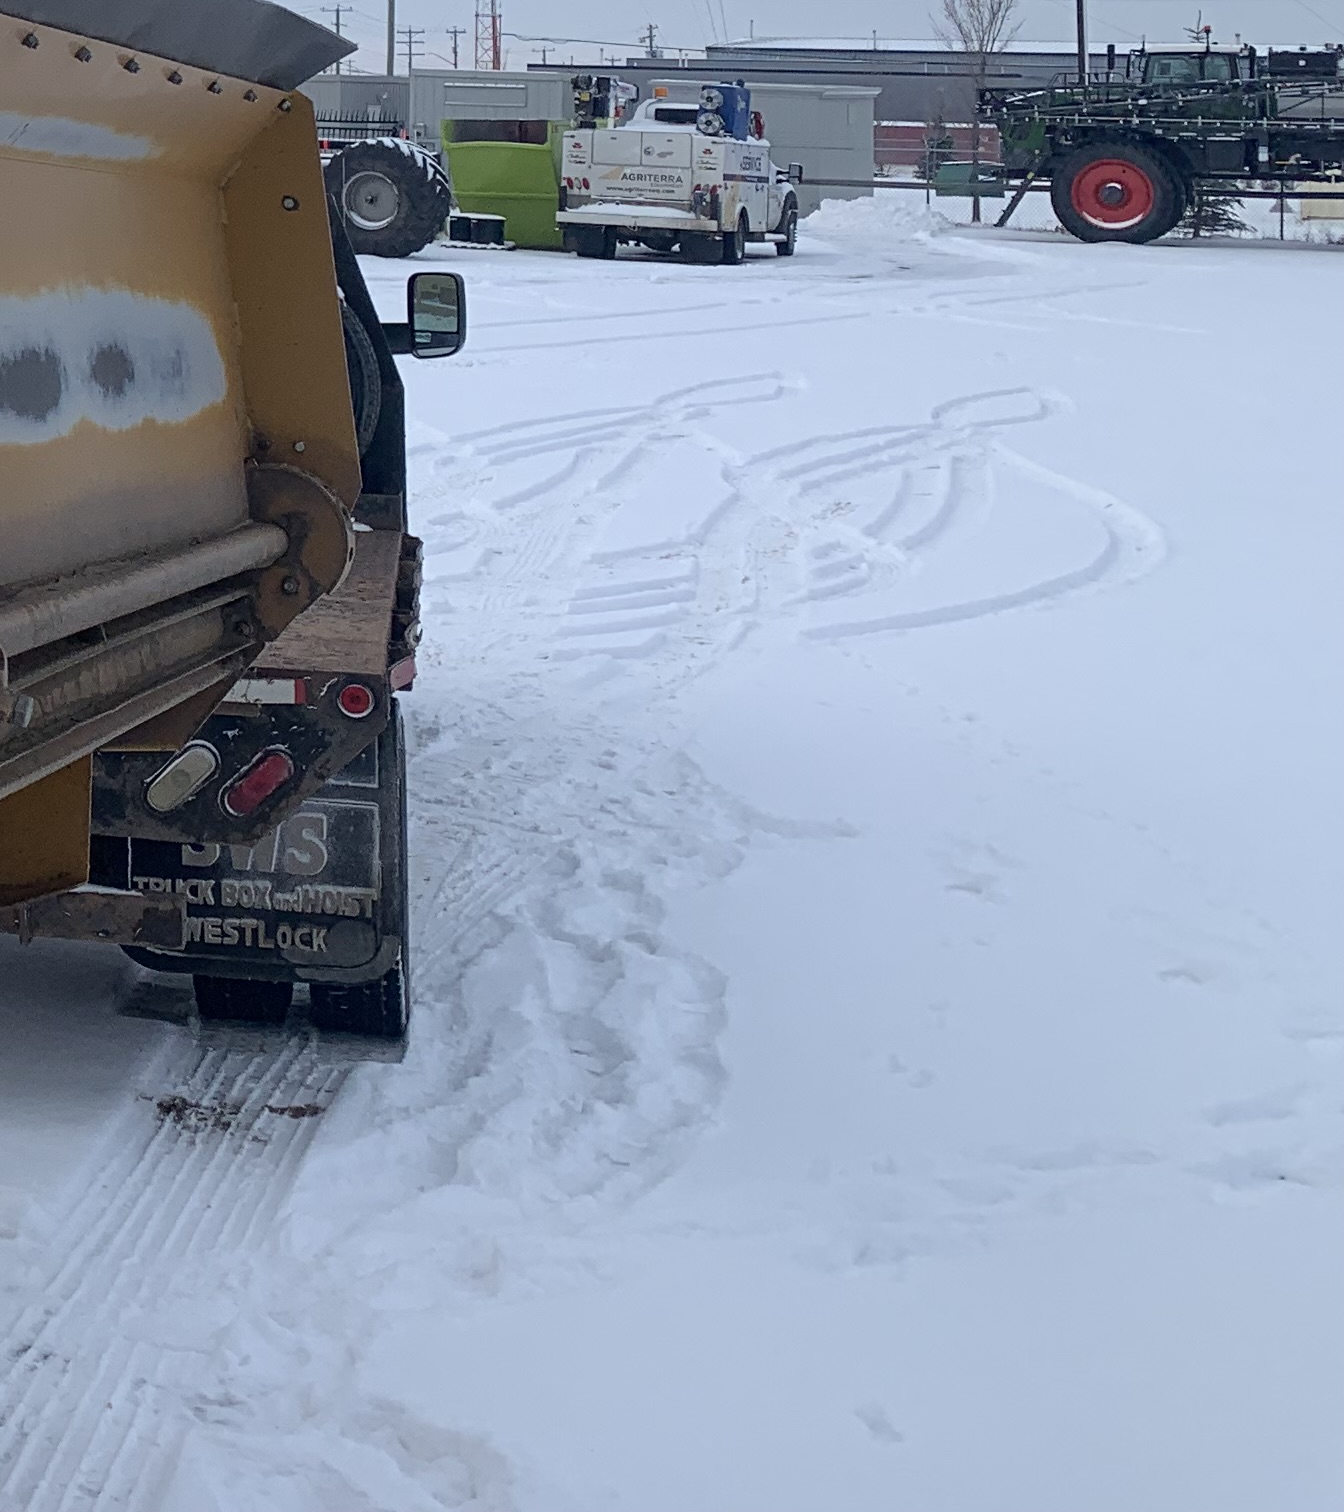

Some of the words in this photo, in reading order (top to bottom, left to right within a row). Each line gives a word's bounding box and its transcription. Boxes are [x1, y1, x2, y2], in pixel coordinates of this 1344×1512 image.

[621, 173, 683, 184] AGRITERRA
[220, 879, 272, 911] BOX
[302, 885, 379, 918] HOIST
[186, 916, 328, 953] WESTLOCK
